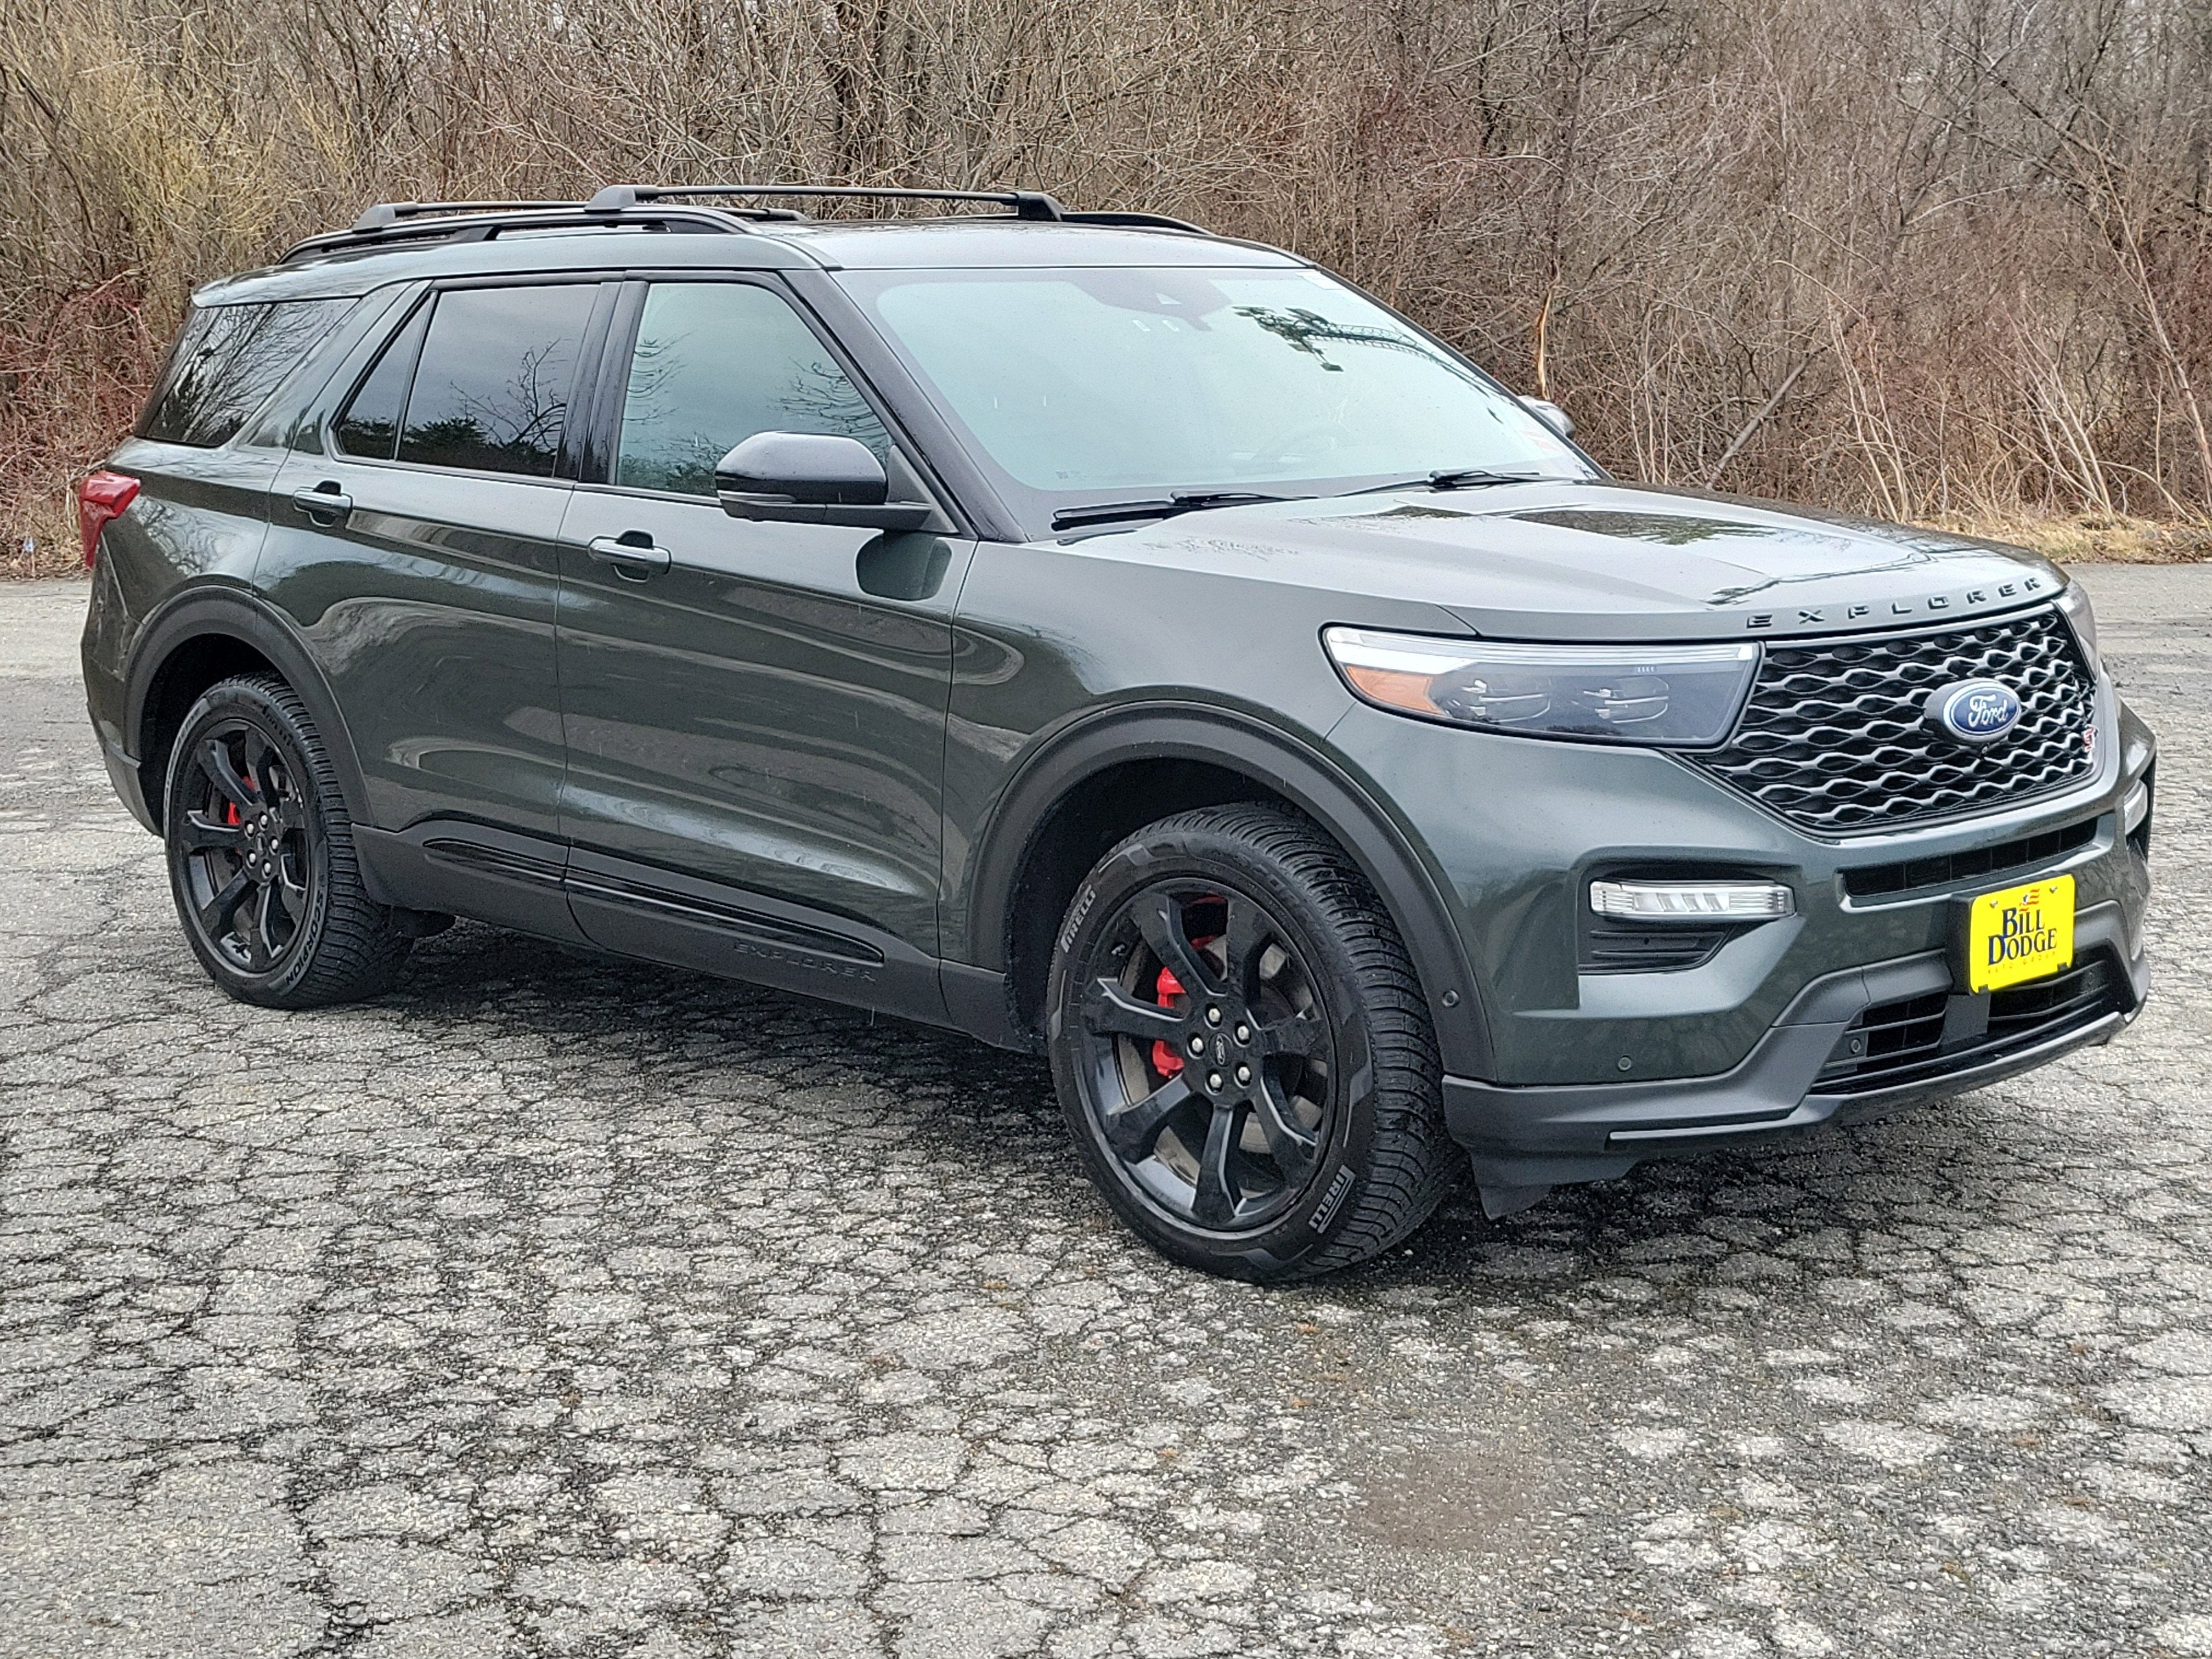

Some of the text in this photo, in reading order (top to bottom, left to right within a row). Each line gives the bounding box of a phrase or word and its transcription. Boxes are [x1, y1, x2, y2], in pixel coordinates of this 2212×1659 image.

[1746, 578, 2042, 629] EXPLORER
[1967, 693, 2009, 727] Ford
[285, 889, 324, 985] SCORPION
[1988, 928, 2058, 966] DODGE
[733, 943, 876, 981] EXPLORER
[1308, 1164, 1356, 1233] PIRELLI
